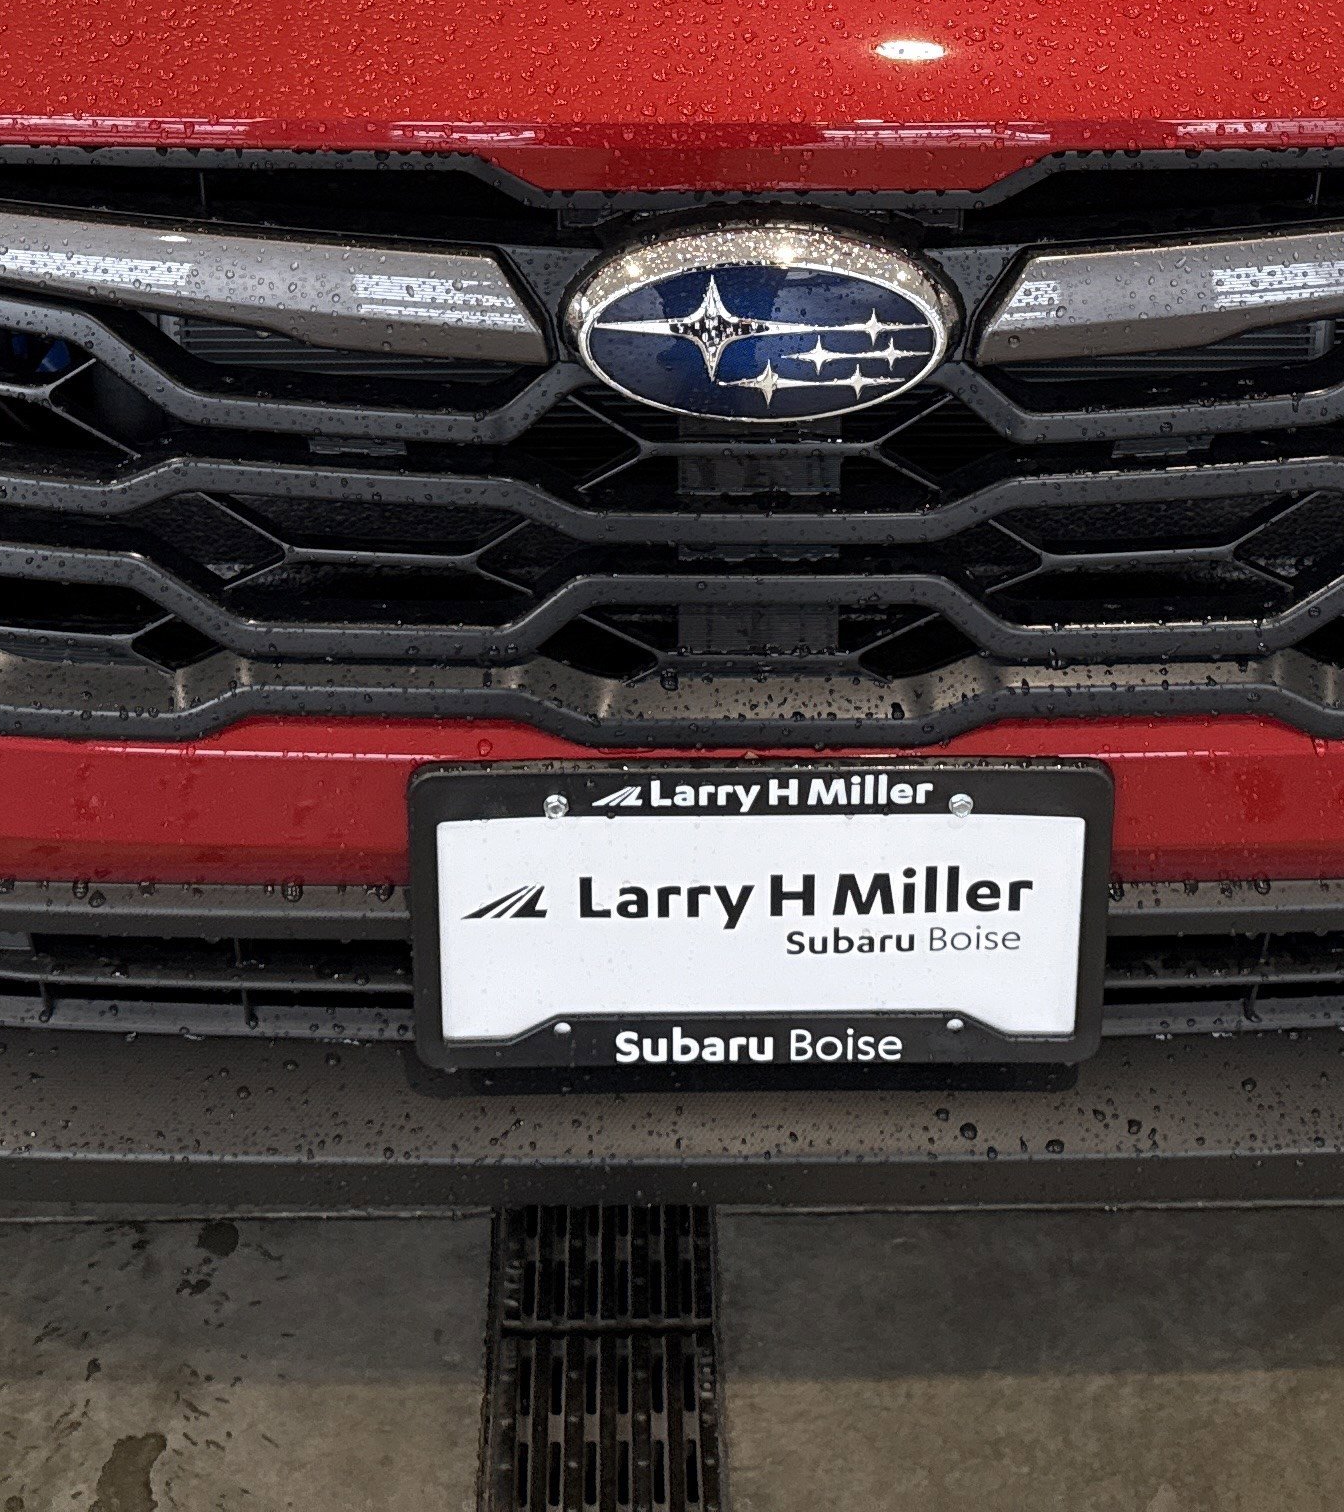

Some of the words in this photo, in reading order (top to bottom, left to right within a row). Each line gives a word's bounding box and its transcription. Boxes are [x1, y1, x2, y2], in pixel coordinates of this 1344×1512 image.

[649, 779, 760, 813] Larry
[768, 778, 799, 806] H
[806, 773, 934, 806] Miller
[578, 876, 755, 930] Larry
[769, 873, 816, 917] H
[831, 865, 1034, 916] Miller
[786, 926, 915, 955] Subaru
[928, 925, 1021, 952] Boise
[615, 1026, 774, 1063] Subaru
[789, 1027, 903, 1062] Boise
